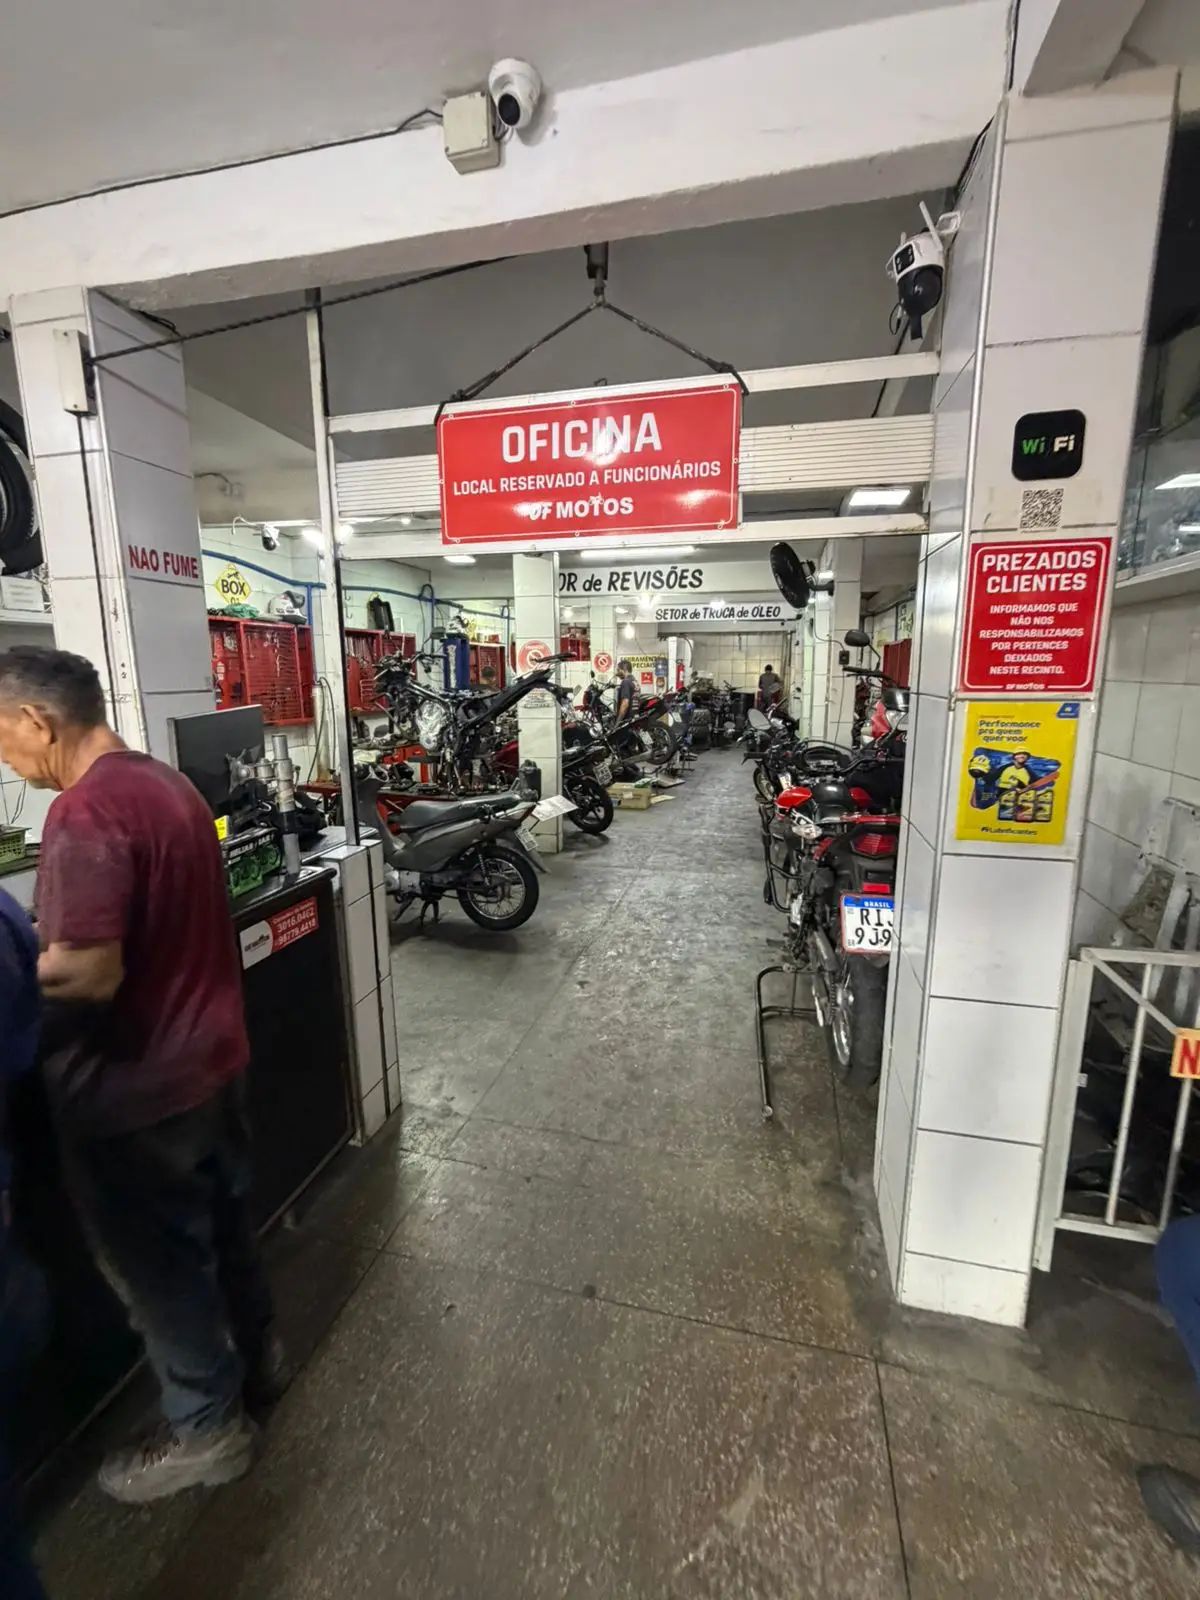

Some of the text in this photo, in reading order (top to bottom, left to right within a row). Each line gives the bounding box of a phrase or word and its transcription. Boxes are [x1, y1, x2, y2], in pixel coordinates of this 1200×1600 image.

[502, 413, 663, 464] OFICINA
[1021, 435, 1075, 454] Wi Fi
[453, 459, 721, 496] LOCAL RESERVADO A FUNCIONÁRIOS
[556, 496, 634, 519] MOTOS
[128, 545, 199, 579] NAO FUME
[982, 549, 1097, 573] PREZADOS
[221, 579, 247, 596] BOX
[582, 573, 602, 592] de
[607, 566, 704, 592] REVISÕES
[986, 572, 1088, 594] CLIENTES
[655, 608, 689, 621] SETOR
[689, 608, 701, 620] de
[736, 606, 749, 618] de
[990, 602, 1079, 614] INFORMAMOS QUE
[1010, 614, 1055, 626] NÃO NOS
[979, 627, 1085, 639] RESPONSABILIZAMOS
[991, 640, 1069, 650] POR PERTENCES
[1003, 653, 1053, 663] DEIXADOS
[989, 665, 1065, 675] NESTE RECINTO.
[978, 719, 1042, 729] Performance
